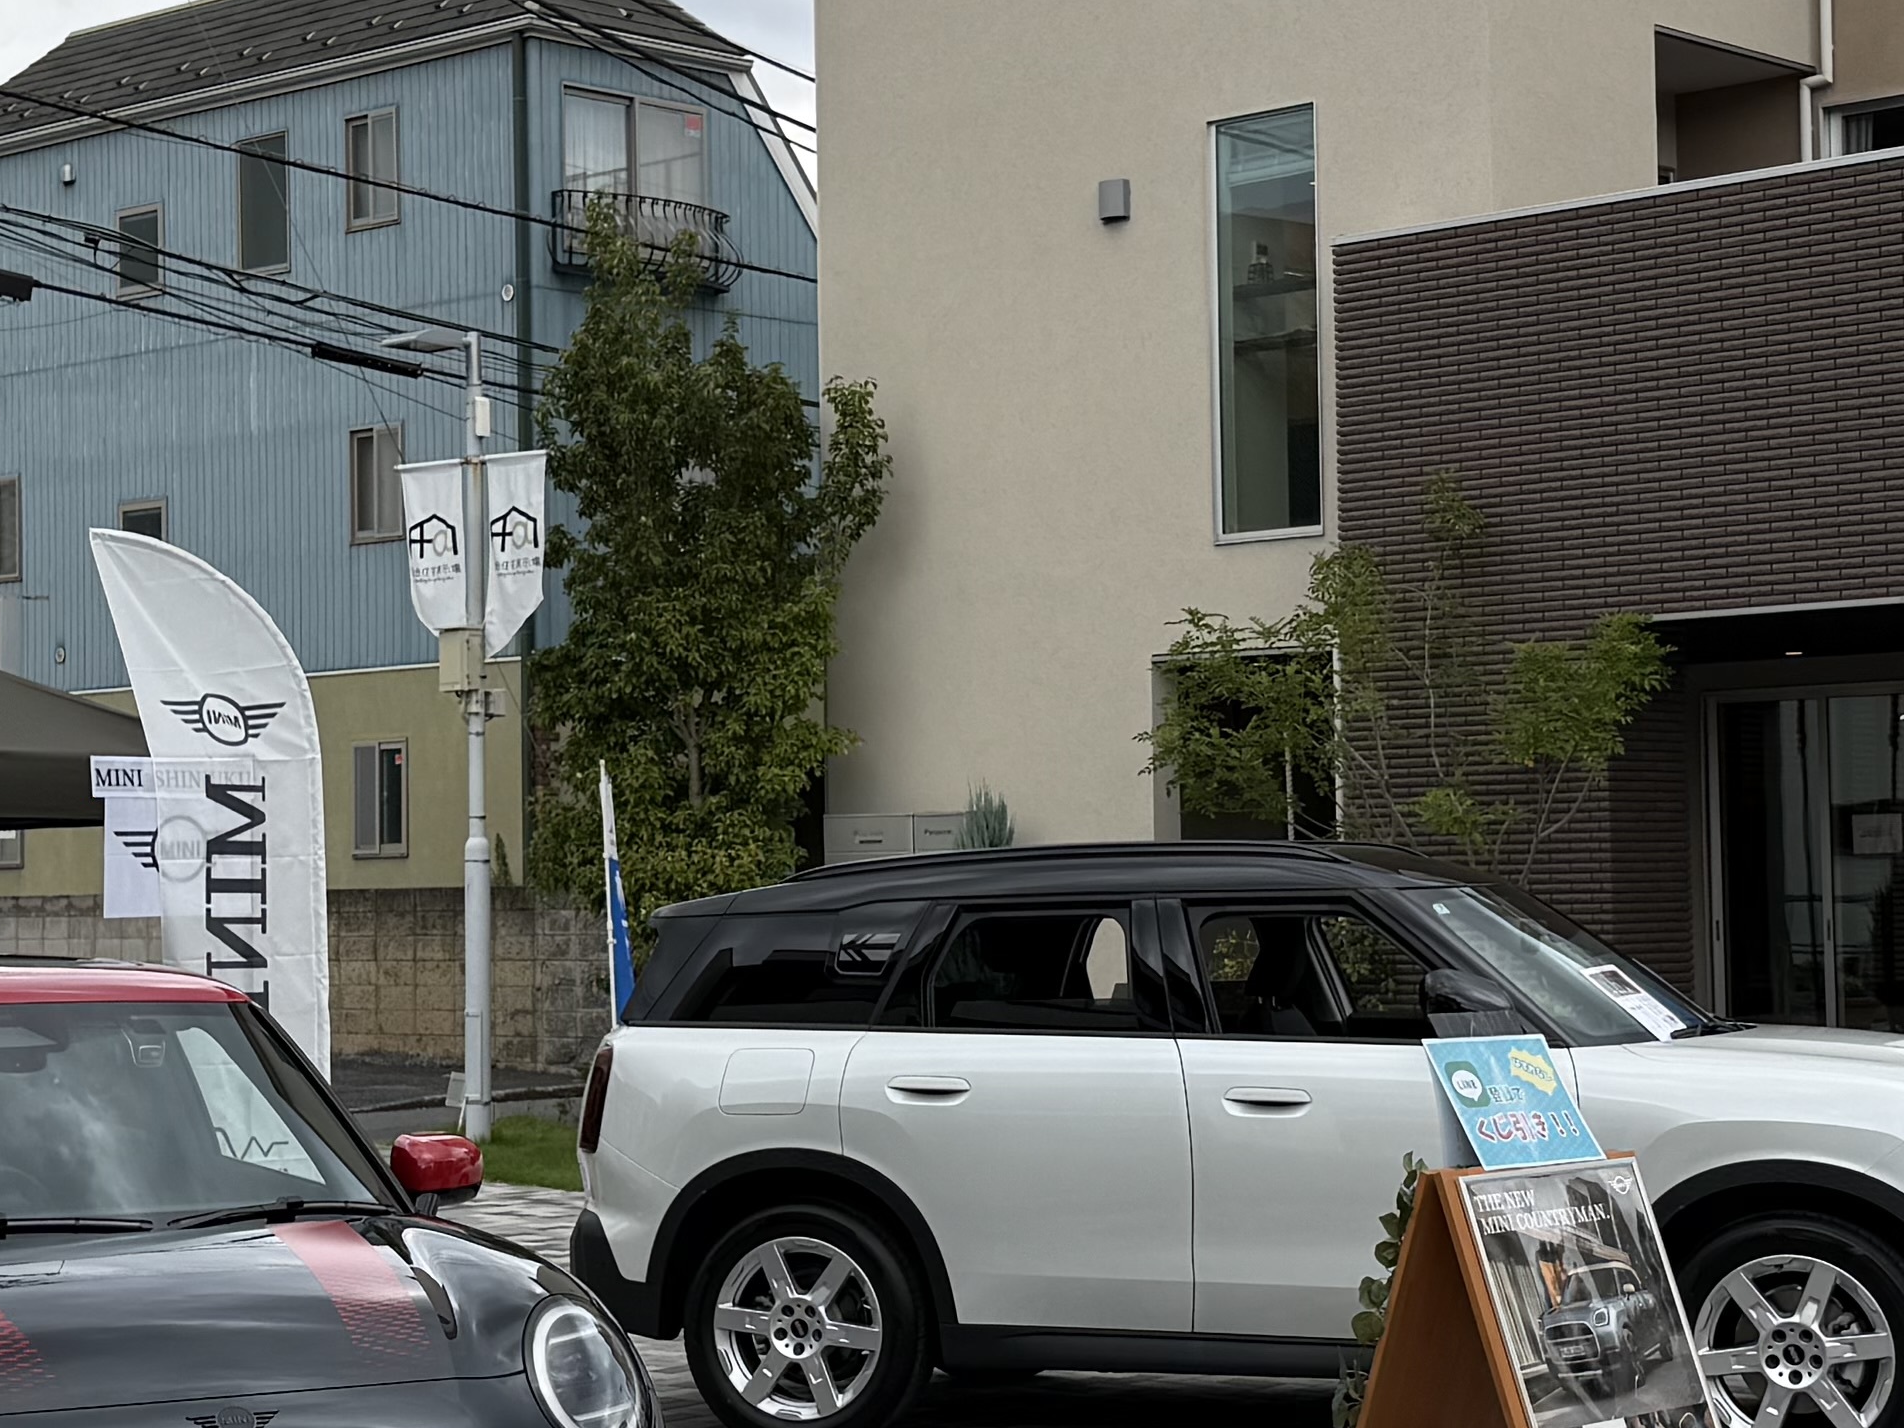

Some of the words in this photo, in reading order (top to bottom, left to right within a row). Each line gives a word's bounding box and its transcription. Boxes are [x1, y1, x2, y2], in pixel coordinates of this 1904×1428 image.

[95, 768, 143, 788] MINI
[1474, 1192, 1505, 1213] THE
[1505, 1189, 1536, 1210] NEW
[1479, 1214, 1517, 1236] MINI
